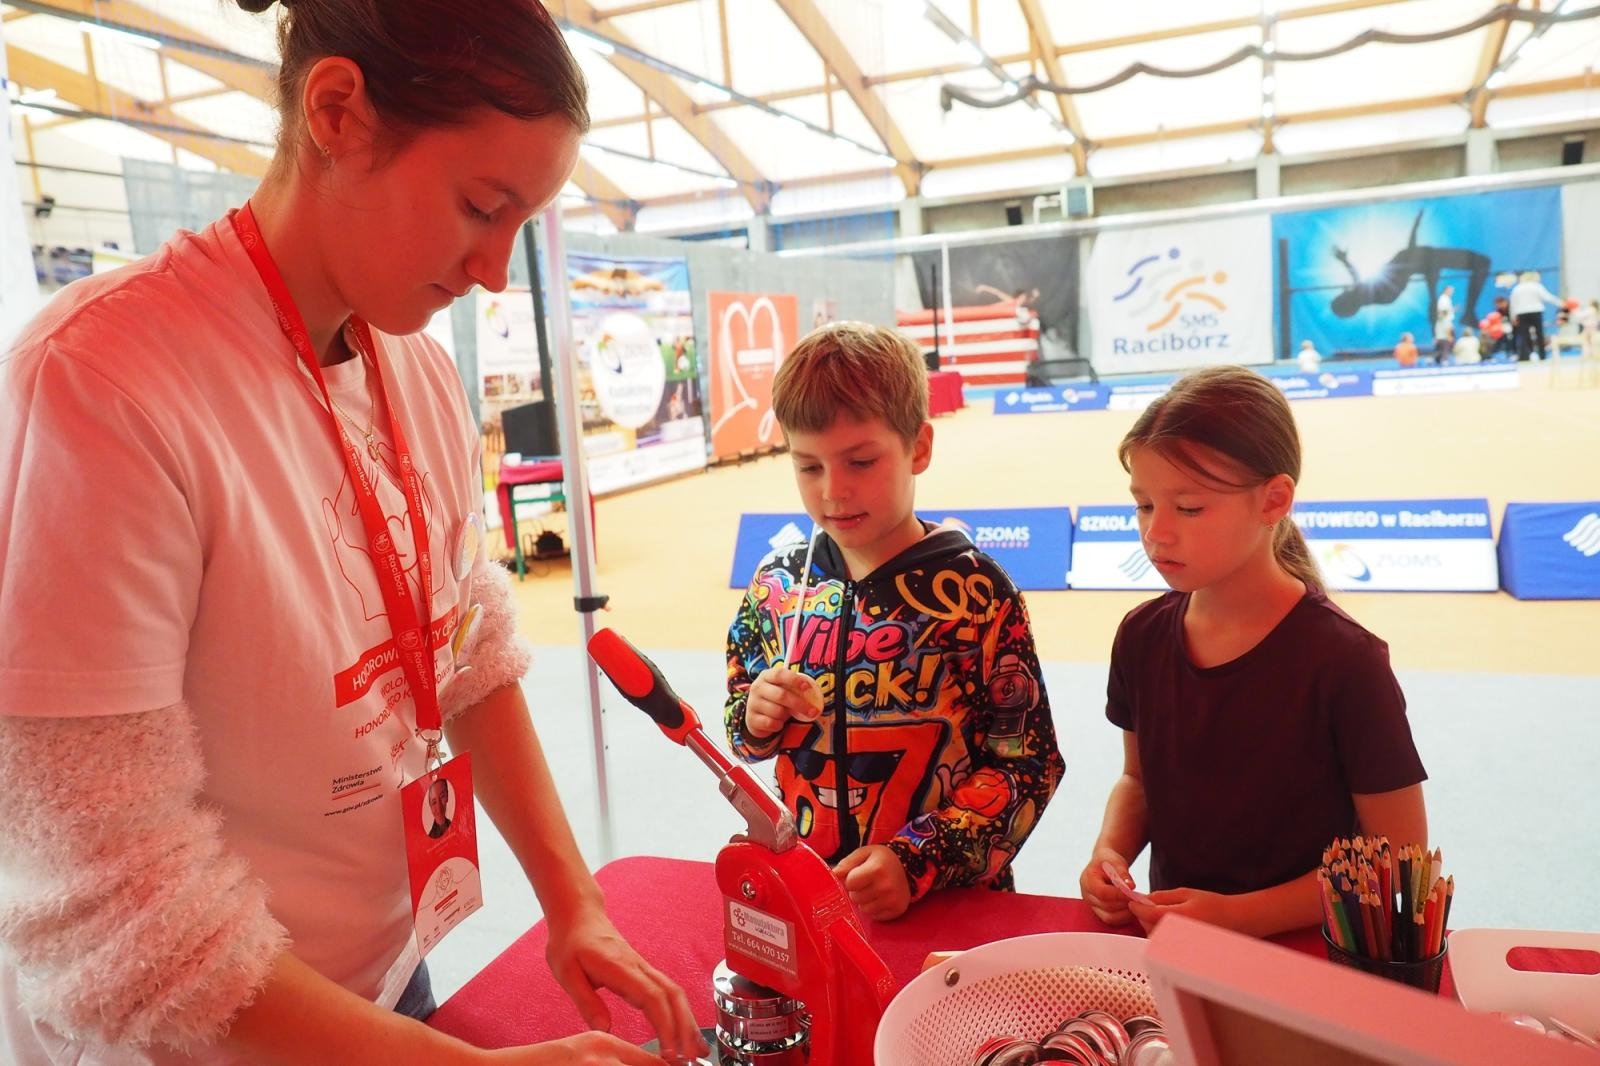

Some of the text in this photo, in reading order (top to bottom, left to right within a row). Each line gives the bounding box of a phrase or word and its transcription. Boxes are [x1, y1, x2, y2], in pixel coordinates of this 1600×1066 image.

[1180, 313, 1219, 329] SMS
[1113, 331, 1230, 355] Racibórz
[1297, 510, 1487, 528] RTOWEGO w Raciborzu
[975, 526, 1030, 541] ZSOMS
[388, 553, 406, 597] Racibórz
[332, 765, 383, 785] Ministerstwo
[332, 780, 365, 794] Zdrowia
[731, 930, 746, 945] Tel.
[746, 938, 761, 951] 664
[761, 944, 775, 957] 470
[777, 951, 790, 963] 157
